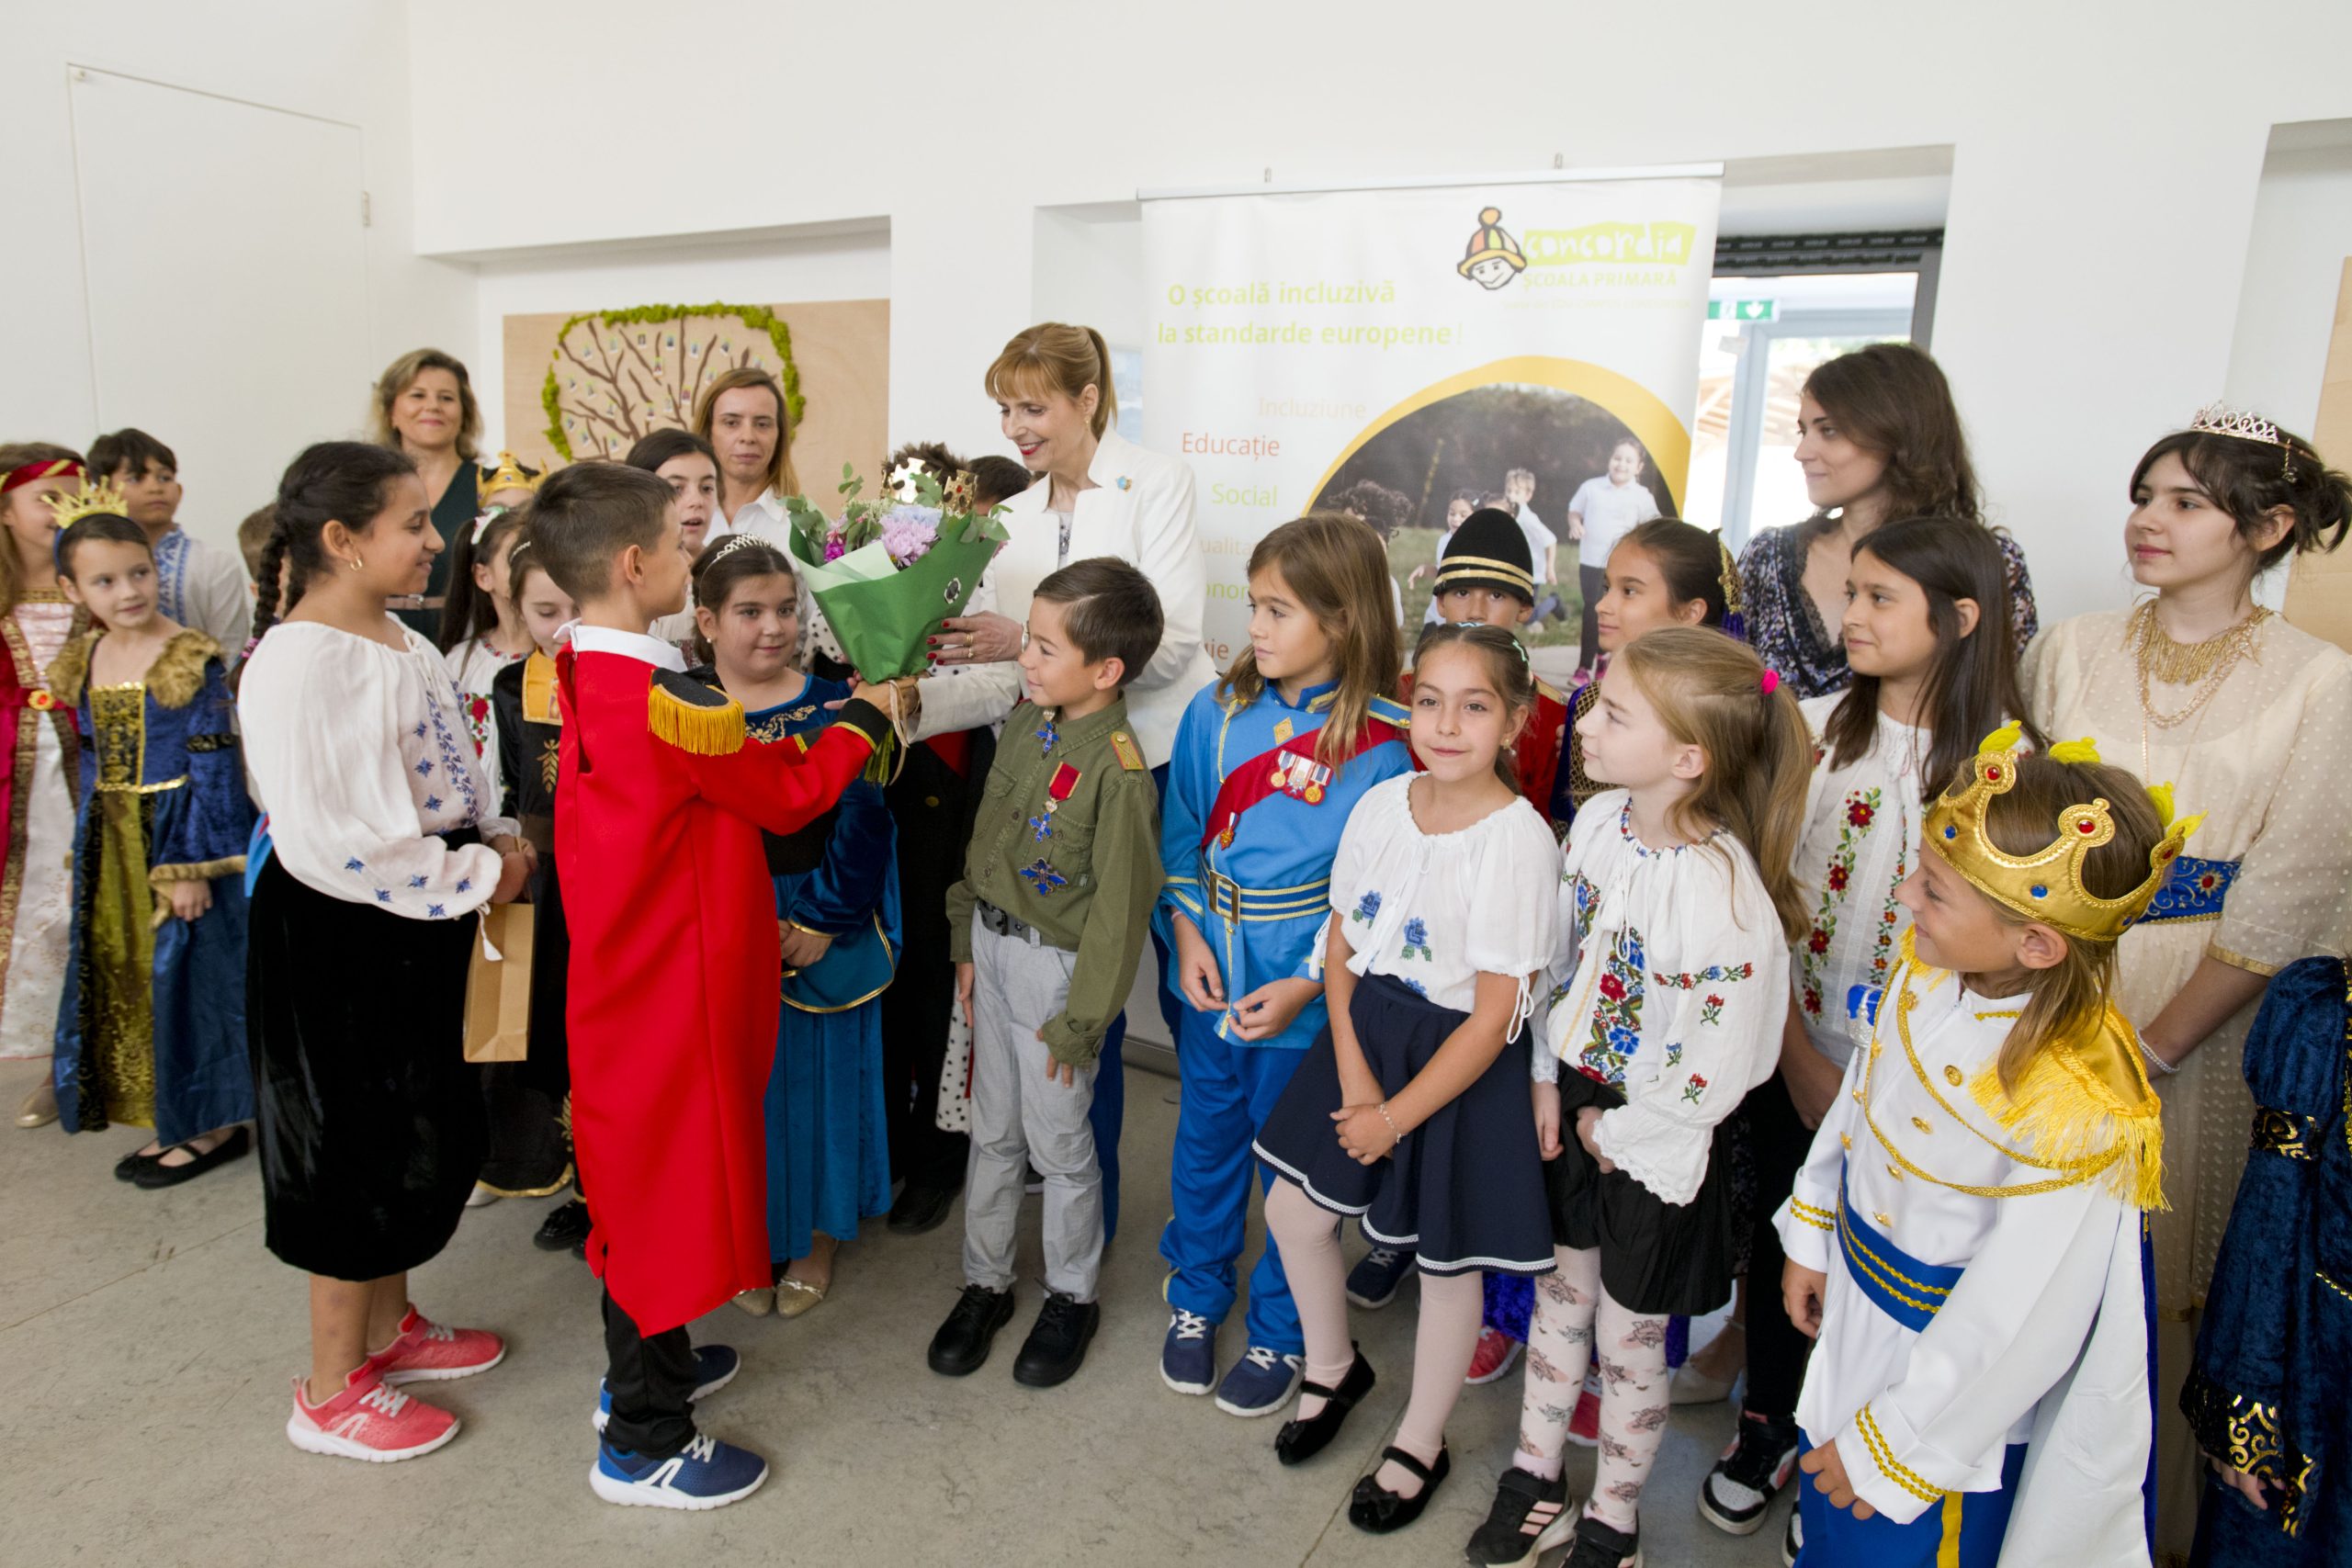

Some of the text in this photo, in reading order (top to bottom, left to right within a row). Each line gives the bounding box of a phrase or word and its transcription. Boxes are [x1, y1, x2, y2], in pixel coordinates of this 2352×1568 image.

[1525, 222, 1683, 259] concordia
[1167, 279, 1396, 309] O școală incluzivă
[1158, 322, 1178, 344] la
[1183, 321, 1312, 344] standarde
[1257, 396, 1367, 419] Incluziune
[1182, 432, 1280, 462] Educație
[1211, 482, 1278, 507] Social
